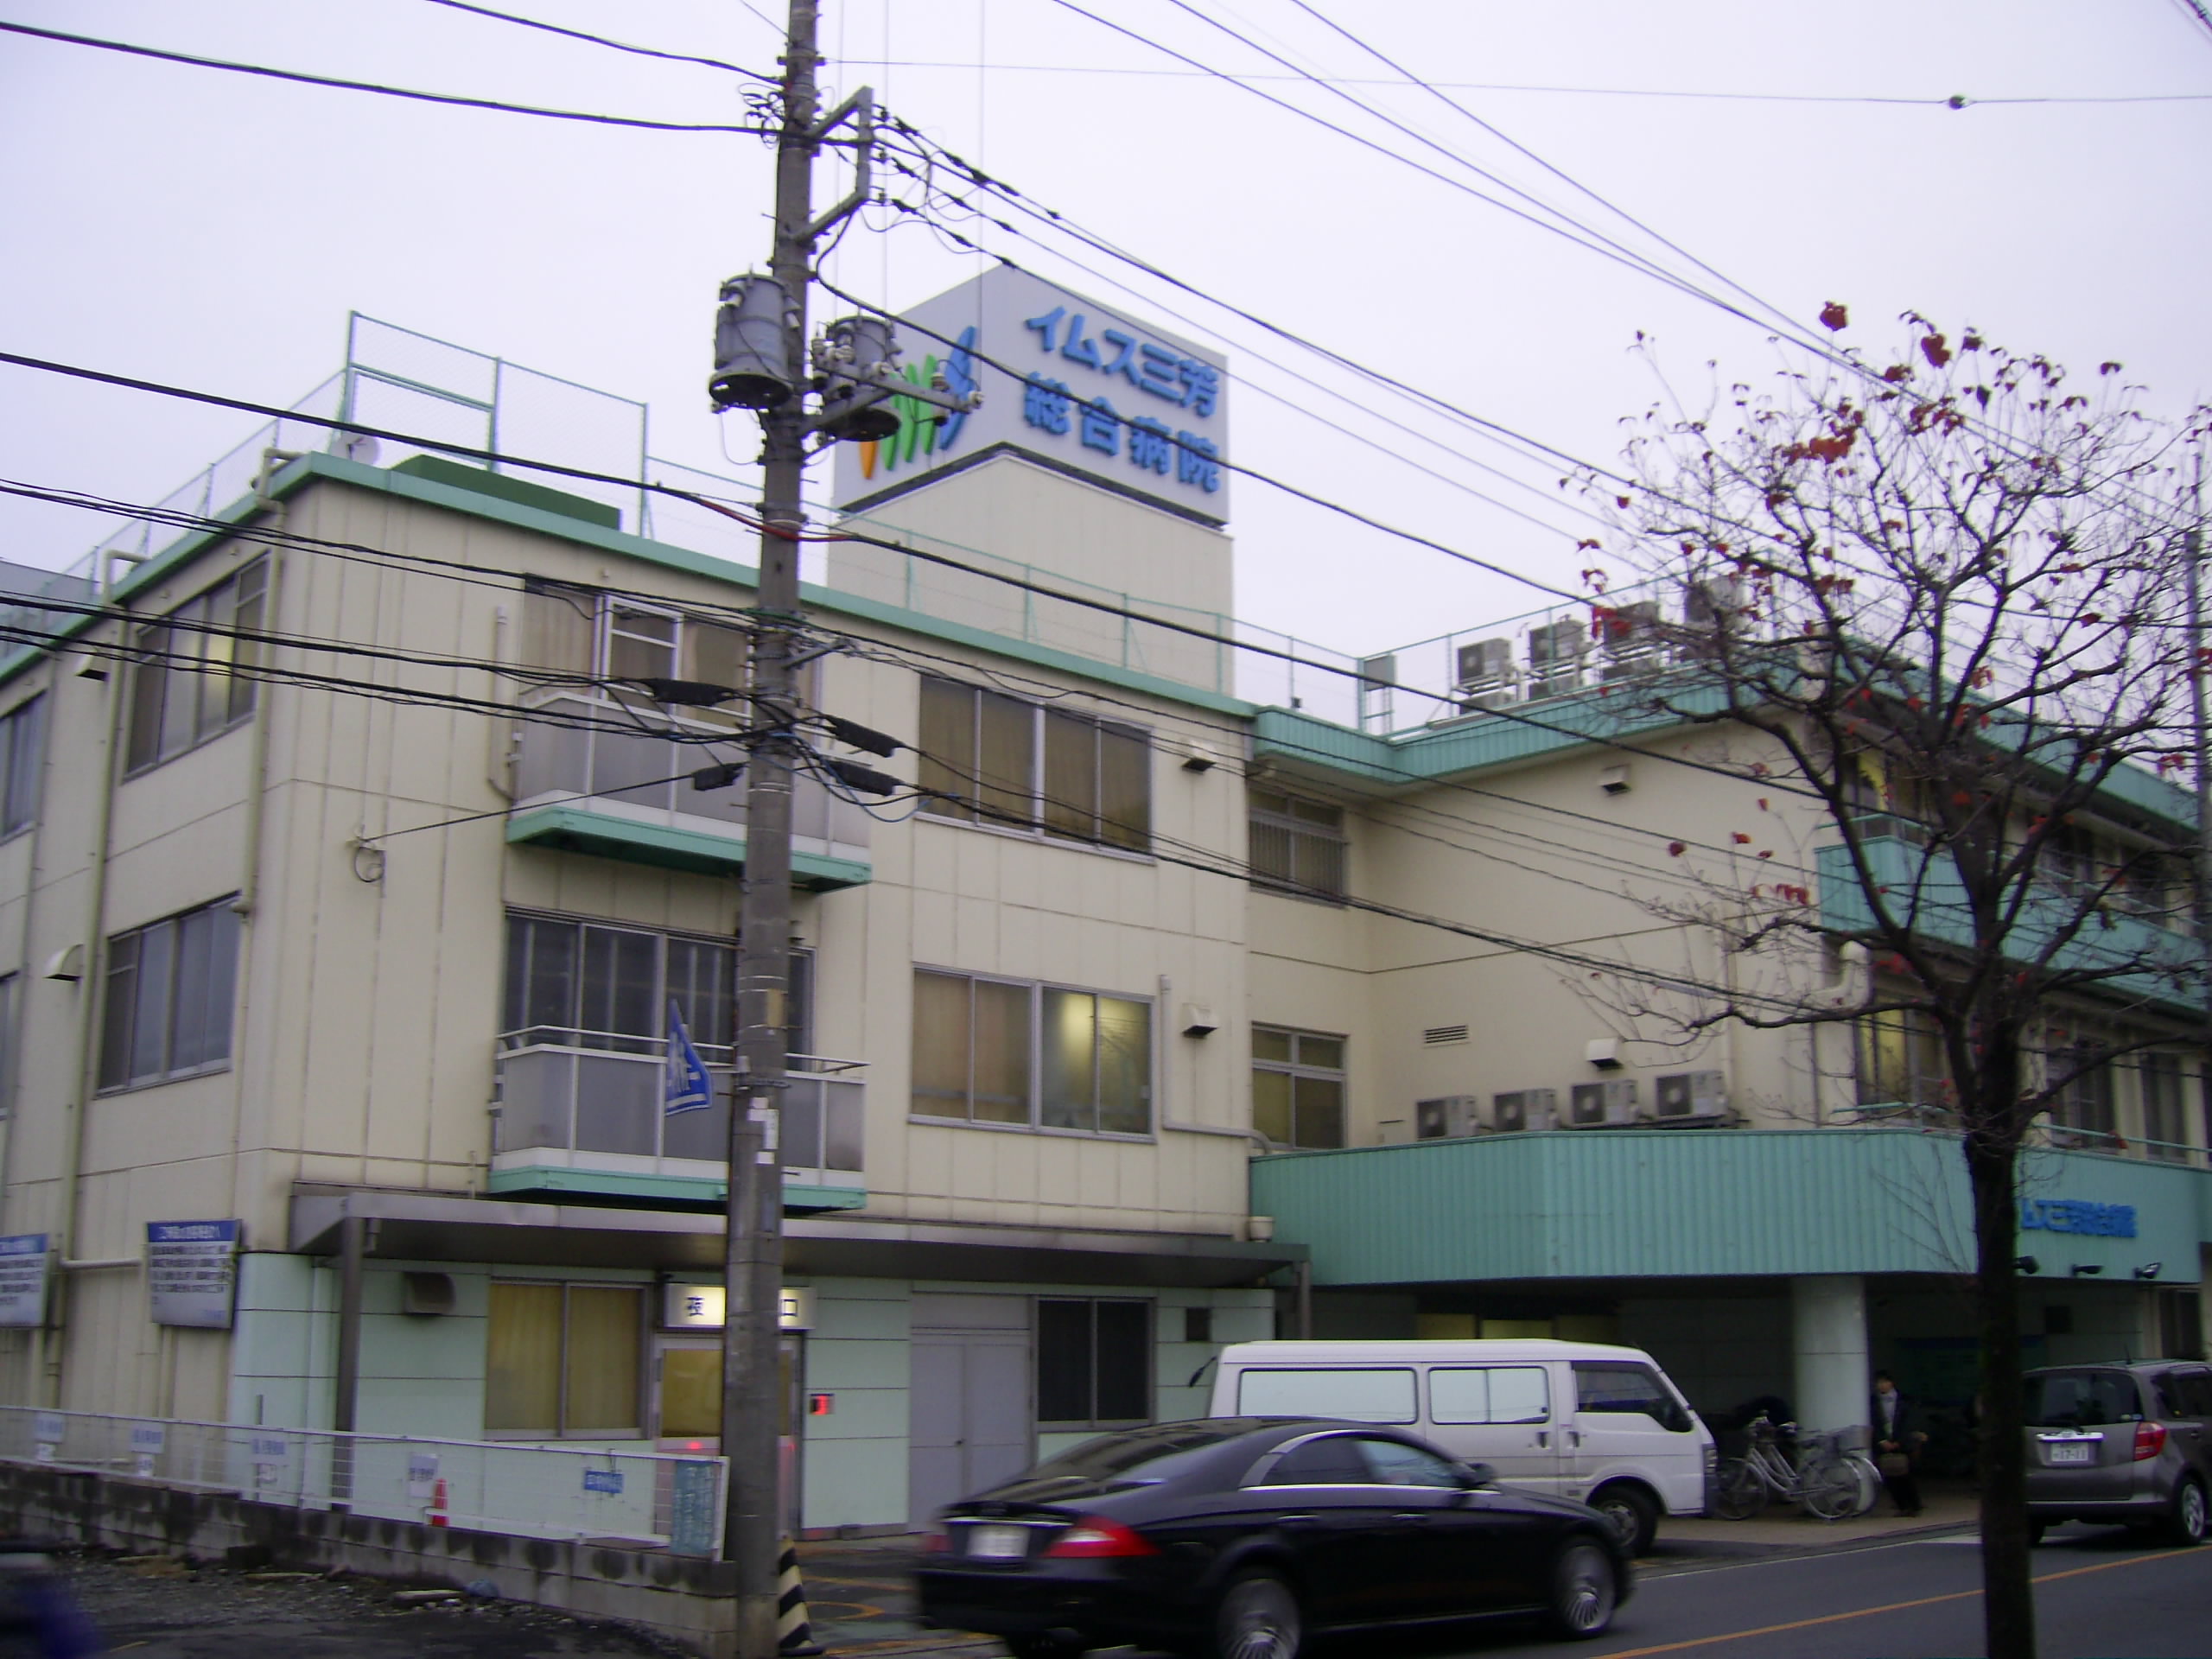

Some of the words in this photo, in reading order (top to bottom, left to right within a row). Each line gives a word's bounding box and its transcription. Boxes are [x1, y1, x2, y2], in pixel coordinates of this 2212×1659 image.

[1025, 305, 1219, 418] イムス三芳
[1023, 371, 1221, 493] 総合病院
